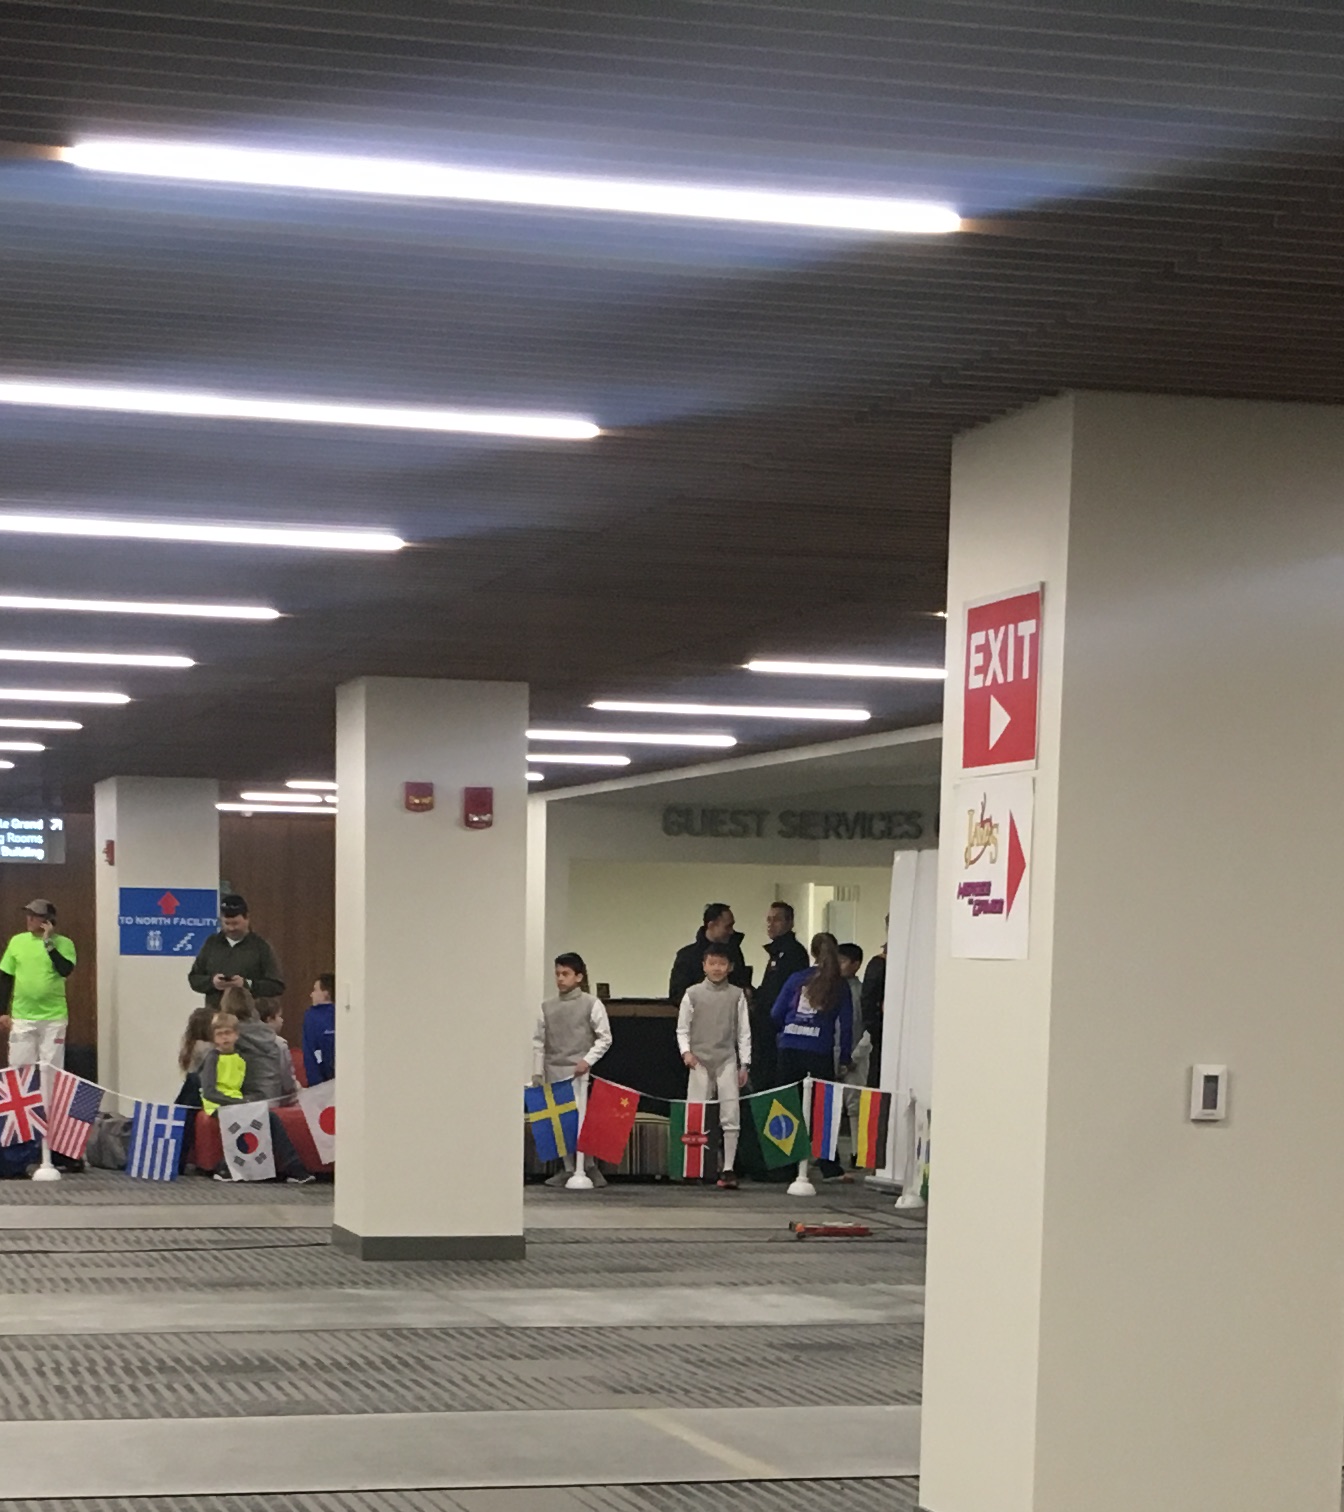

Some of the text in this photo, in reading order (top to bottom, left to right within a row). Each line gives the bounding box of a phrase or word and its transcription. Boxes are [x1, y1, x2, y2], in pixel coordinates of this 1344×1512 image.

[968, 619, 1036, 690] EXIT
[10, 817, 44, 830] Grand
[662, 803, 770, 839] GUEST
[777, 809, 924, 841] SERVICES
[7, 832, 44, 844] Rooms
[0, 845, 45, 860] Building
[119, 916, 218, 927] TO NORTH FACILITY
